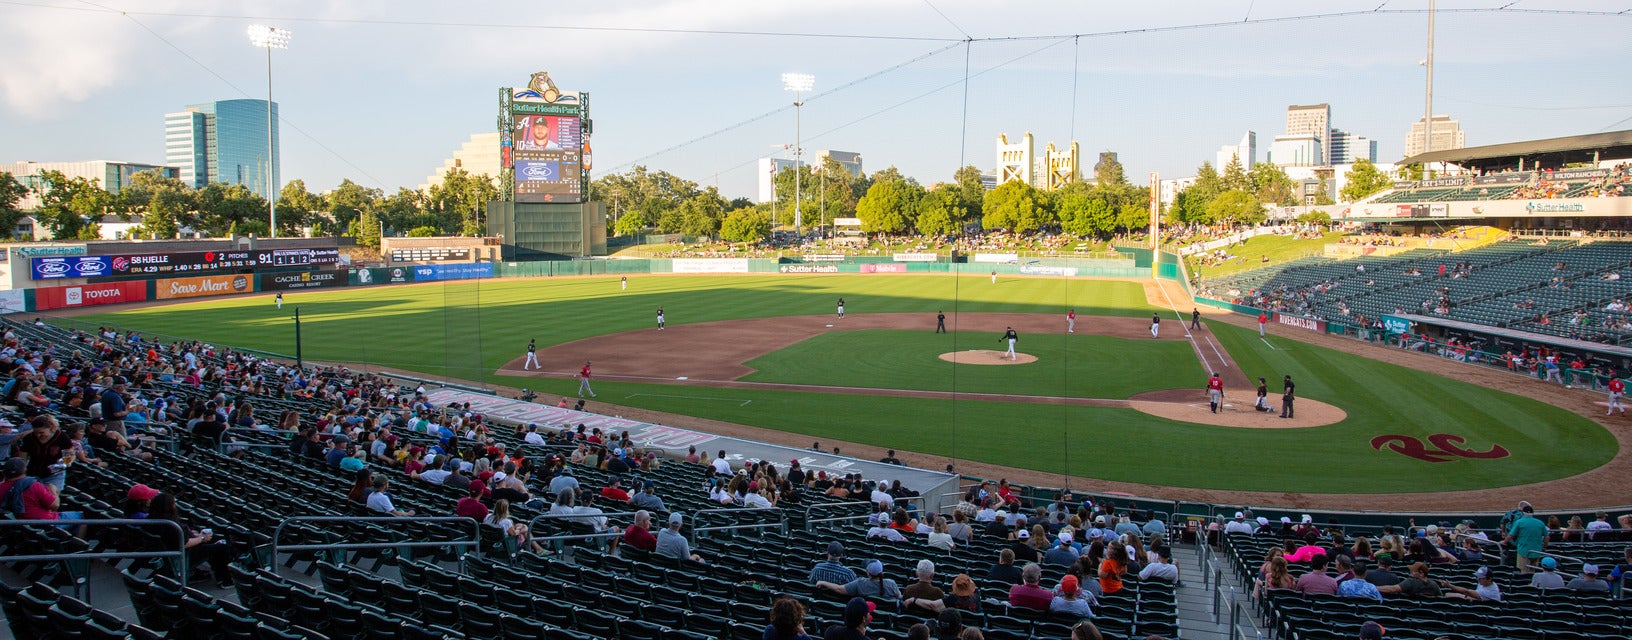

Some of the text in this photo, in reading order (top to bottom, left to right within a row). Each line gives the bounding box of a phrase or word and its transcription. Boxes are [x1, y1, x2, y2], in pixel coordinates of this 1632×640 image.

[513, 103, 579, 114] Sutter Health Park
[1536, 203, 1583, 211] Sutter Health
[30, 246, 85, 255] Sutter Health
[131, 255, 168, 264] 58 HJELLE
[259, 253, 273, 264] 91
[789, 265, 812, 273] Sutter
[275, 275, 301, 283] CACHE
[170, 281, 197, 294] Save
[198, 280, 229, 292] Mart
[85, 288, 120, 298] TOYOTA
[1279, 314, 1318, 330] RIVERCATS.COM
